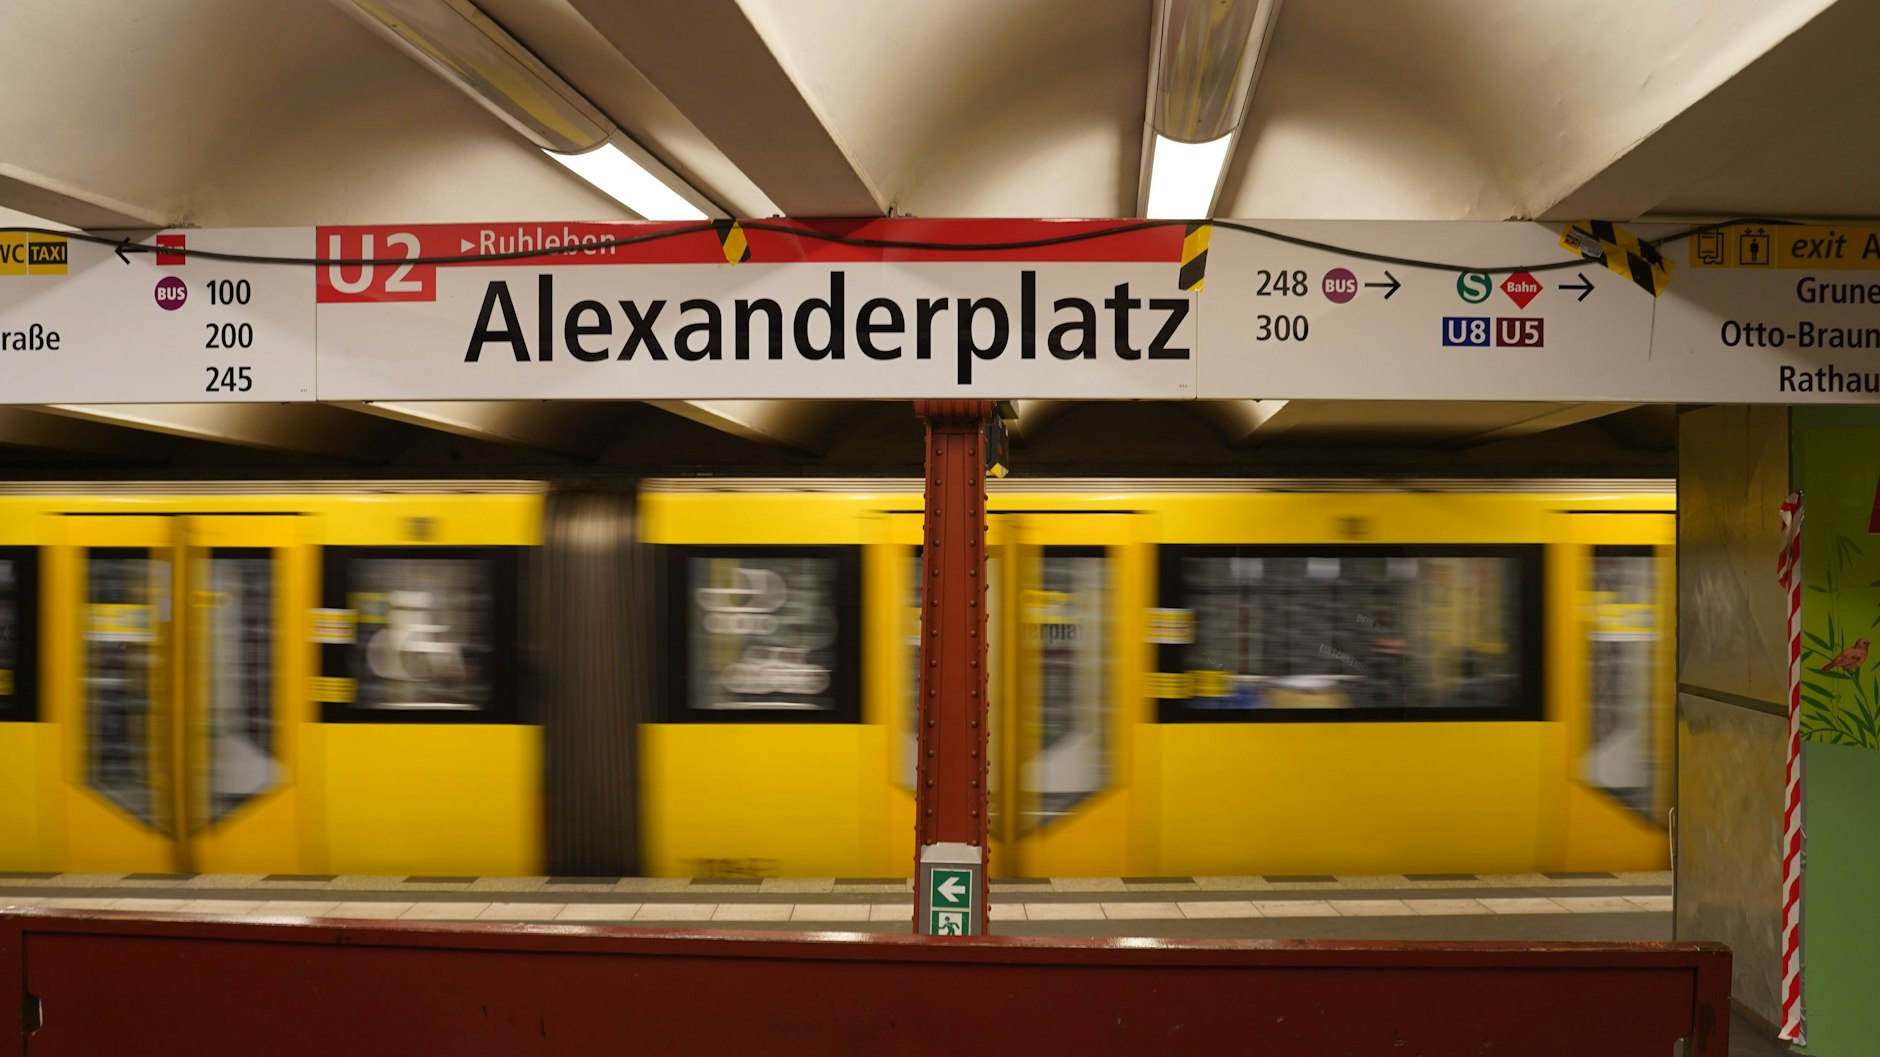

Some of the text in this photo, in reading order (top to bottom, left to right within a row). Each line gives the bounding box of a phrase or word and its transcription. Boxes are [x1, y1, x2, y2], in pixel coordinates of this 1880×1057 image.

[30, 245, 66, 261] TAXI
[479, 226, 616, 256] Ruhleben
[1791, 231, 1847, 259] exit
[328, 232, 423, 294] U2
[157, 279, 251, 306] BUS 100
[1256, 269, 1356, 297] 248 BUS
[1506, 280, 1538, 294] Bahn
[1796, 276, 1880, 305] Grune
[2, 323, 61, 351] raße
[205, 322, 253, 349] 200
[464, 270, 1190, 385] Alexanderplatz
[1256, 314, 1309, 342] 300
[1448, 320, 1486, 344] U8
[1502, 321, 1539, 345] U5
[1720, 319, 1880, 352] Otto-Braun
[205, 366, 253, 392] 245
[1779, 364, 1880, 394] Rathau
